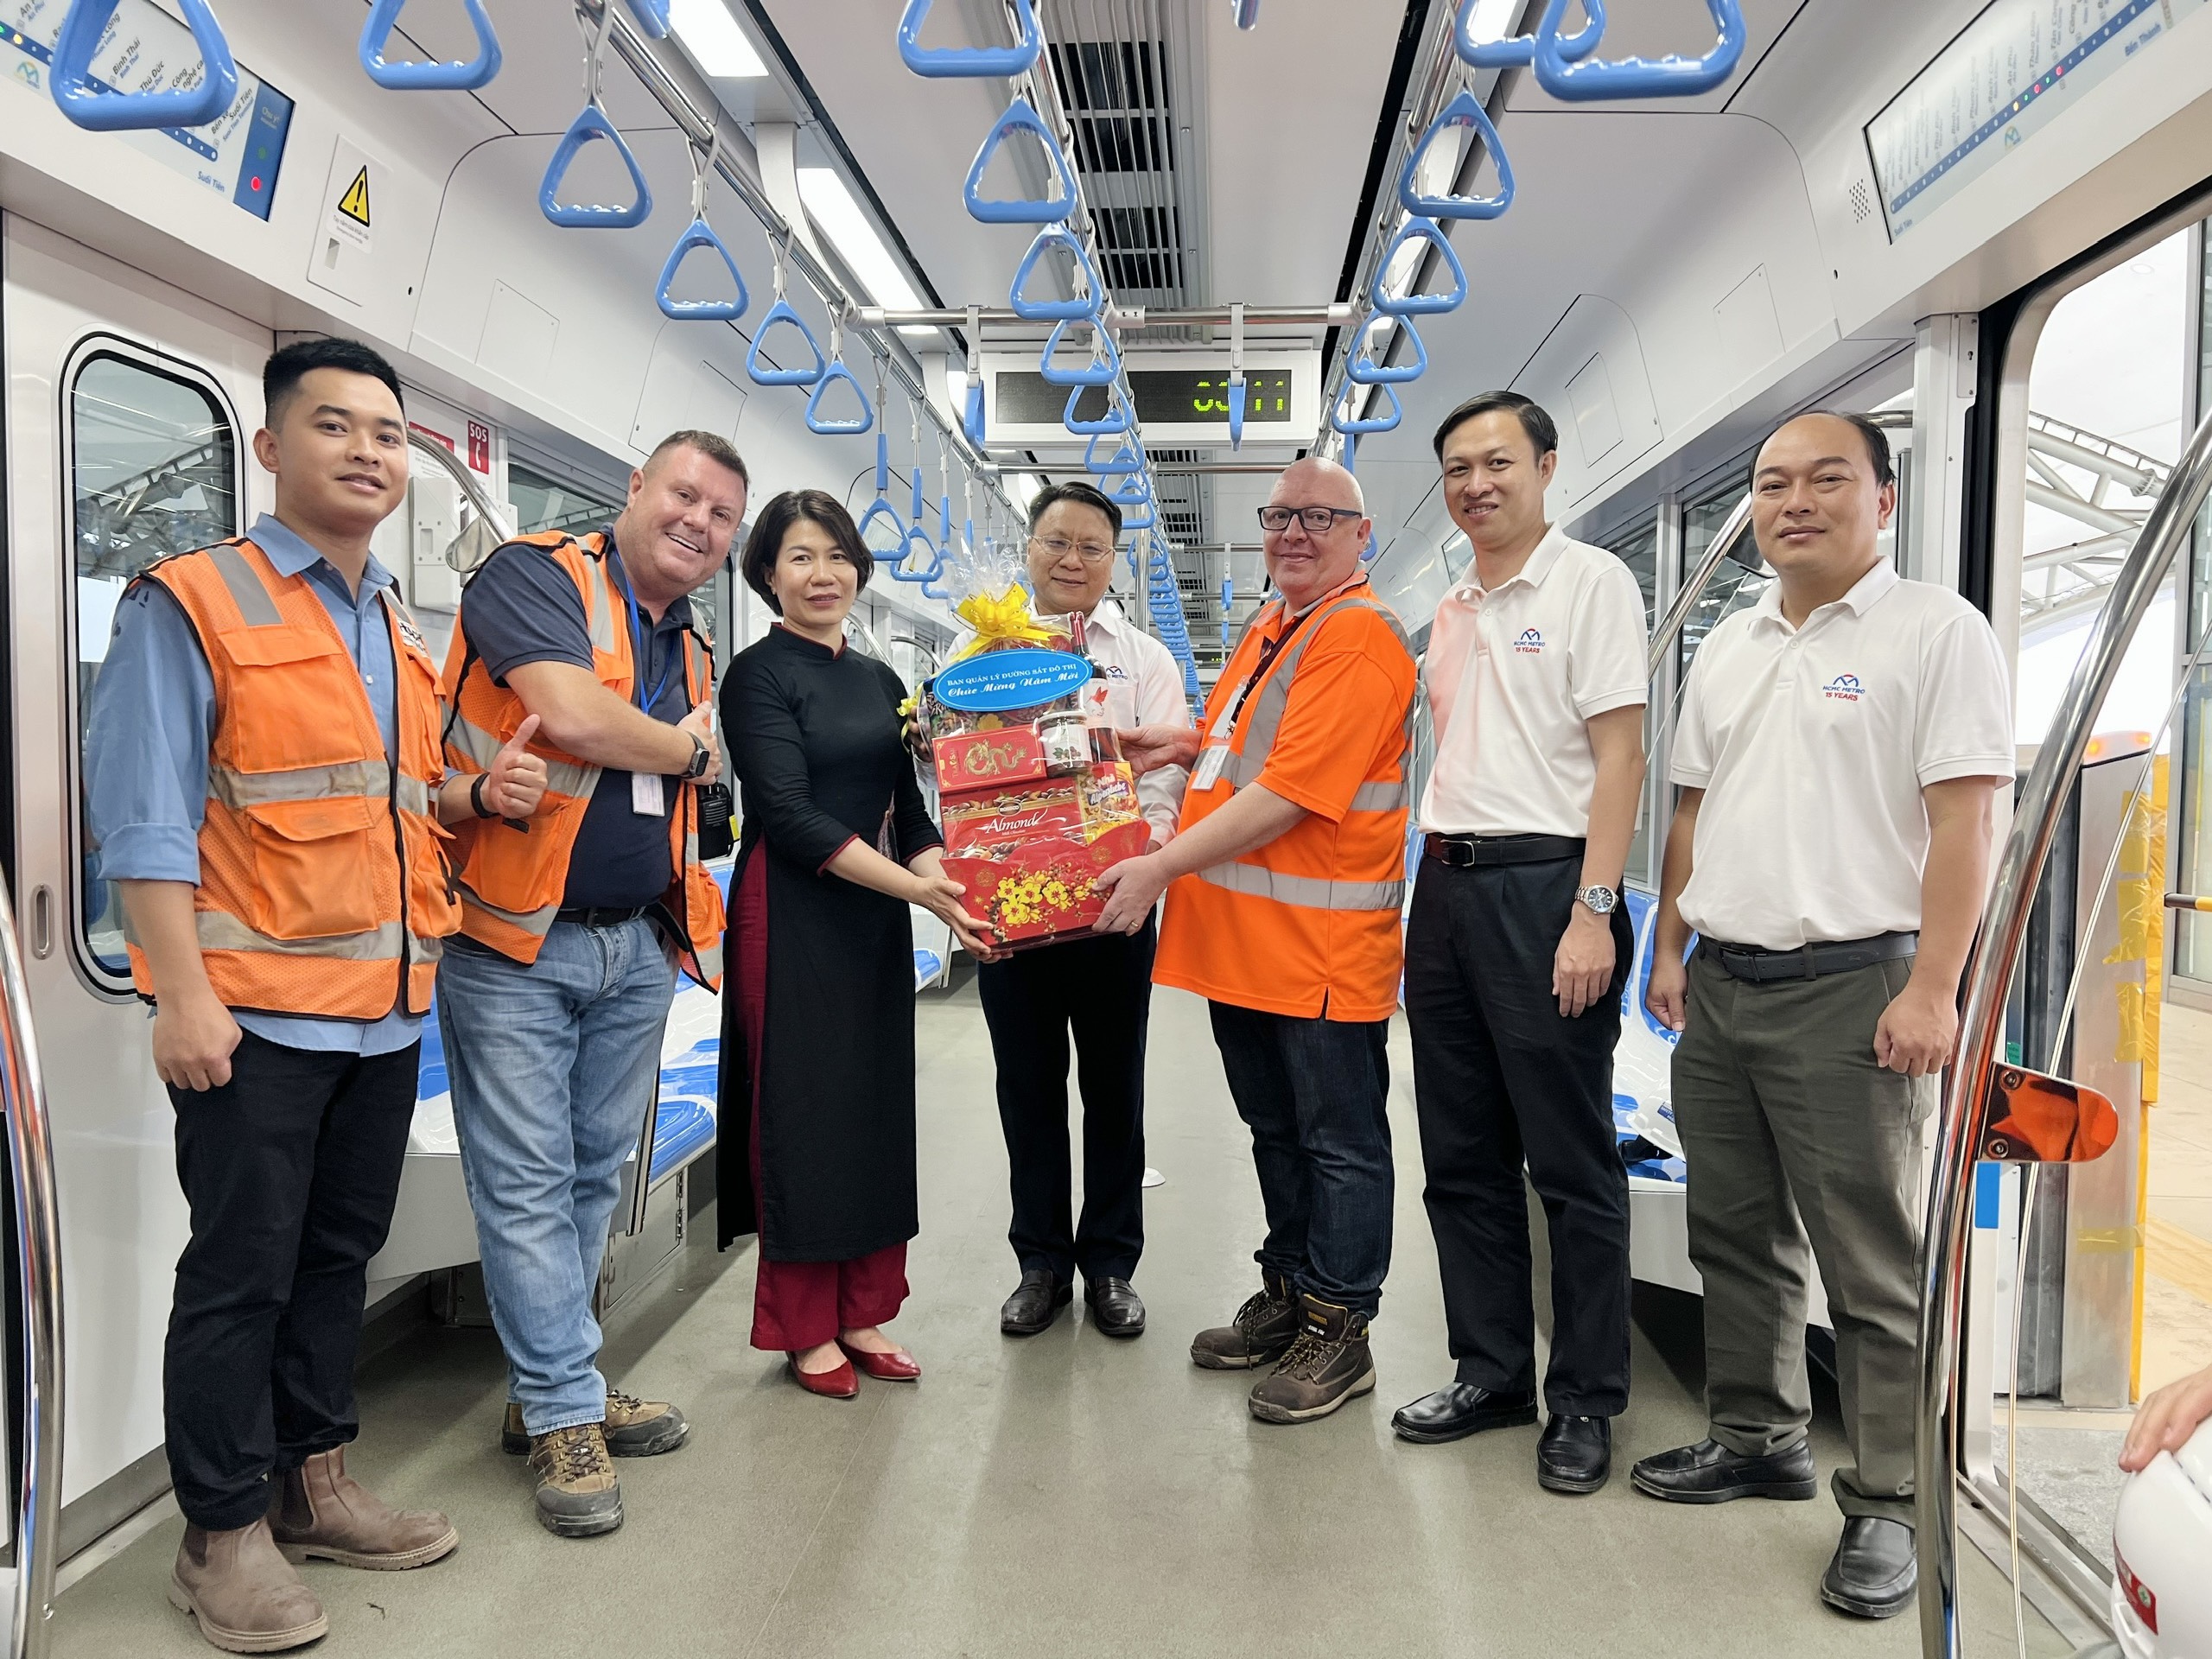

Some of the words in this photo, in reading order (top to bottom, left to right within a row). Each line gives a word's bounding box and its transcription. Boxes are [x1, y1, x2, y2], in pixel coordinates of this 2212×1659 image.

[470, 423, 487, 442] SOS
[947, 678, 964, 687] BAN
[965, 674, 988, 684] QUẢN
[990, 672, 1001, 681] LÝ
[948, 686, 977, 697] Chúc
[980, 682, 1016, 693] Mừng
[1020, 676, 1052, 687] Năm
[1054, 671, 1079, 683] Mới
[1834, 692, 1859, 701] YEARS
[983, 811, 1039, 834] Almond
